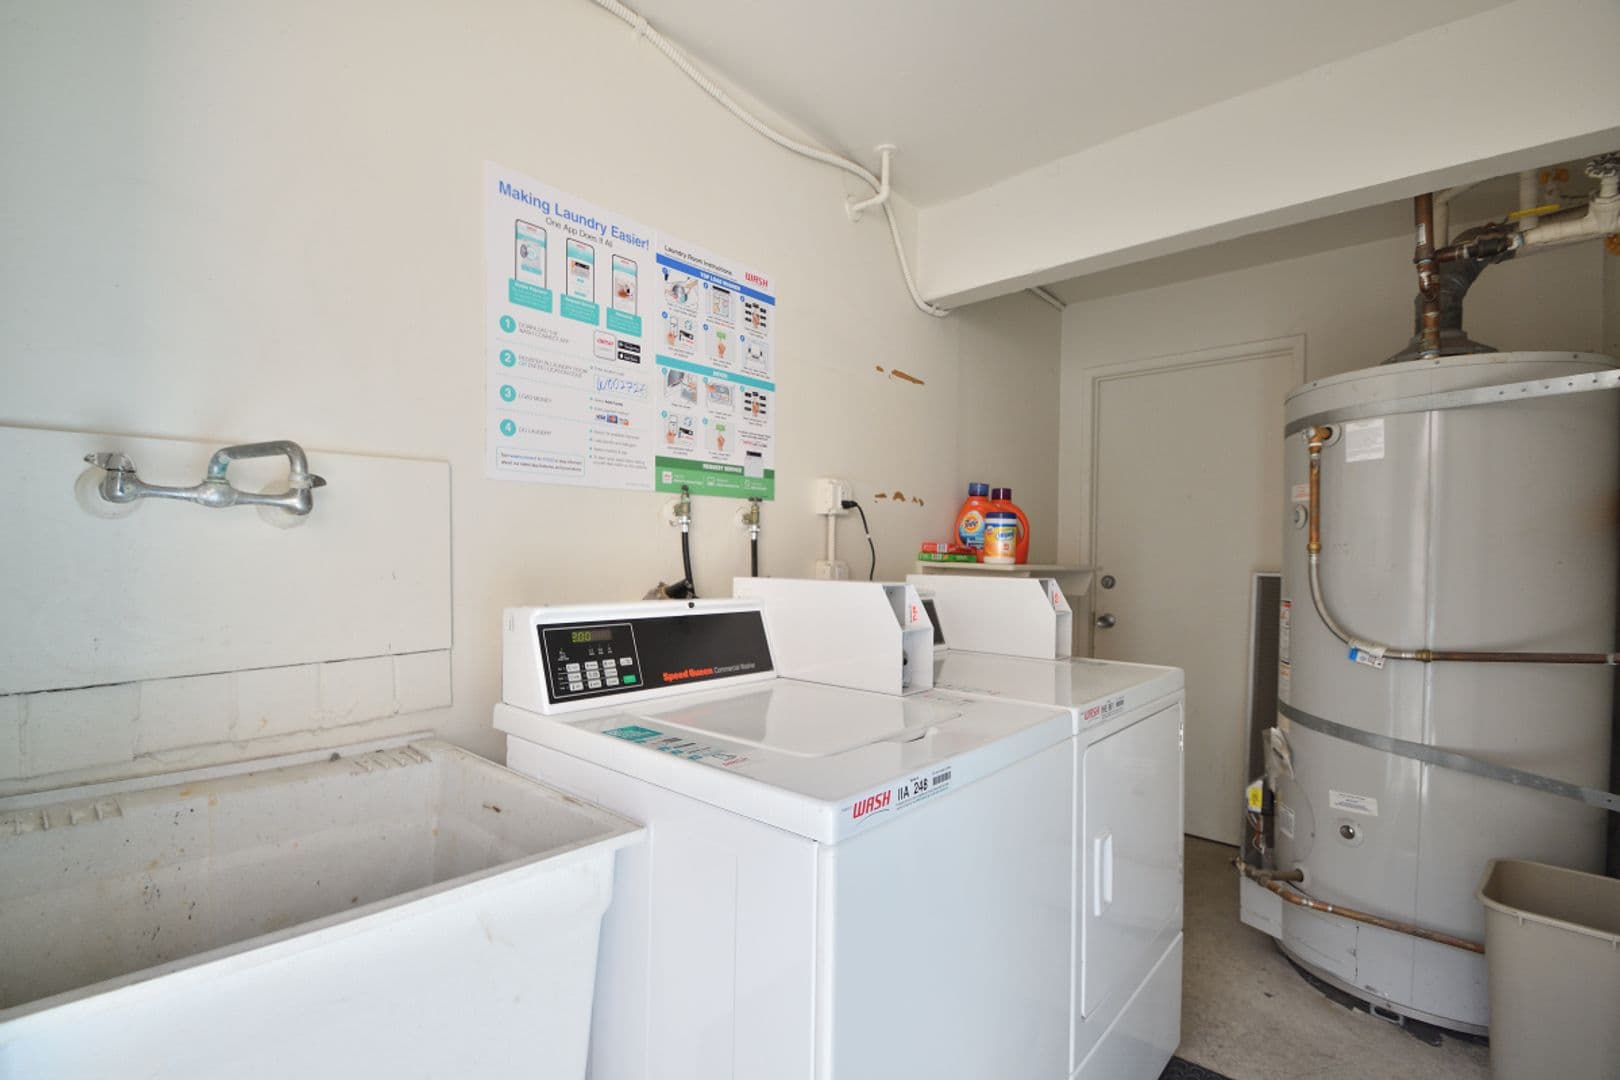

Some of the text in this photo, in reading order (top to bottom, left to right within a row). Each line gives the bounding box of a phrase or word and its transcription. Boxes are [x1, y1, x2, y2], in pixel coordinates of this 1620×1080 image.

[499, 180, 650, 250] Making Laundry Easier!
[546, 217, 561, 230] One
[563, 223, 578, 239] App
[579, 228, 596, 242] Does
[664, 244, 732, 274] Laundry Room Instructions
[745, 272, 768, 287] WASH
[663, 669, 689, 682] Speed
[689, 668, 713, 677] Queen
[714, 665, 740, 674] Commercial
[853, 790, 891, 819] WASH
